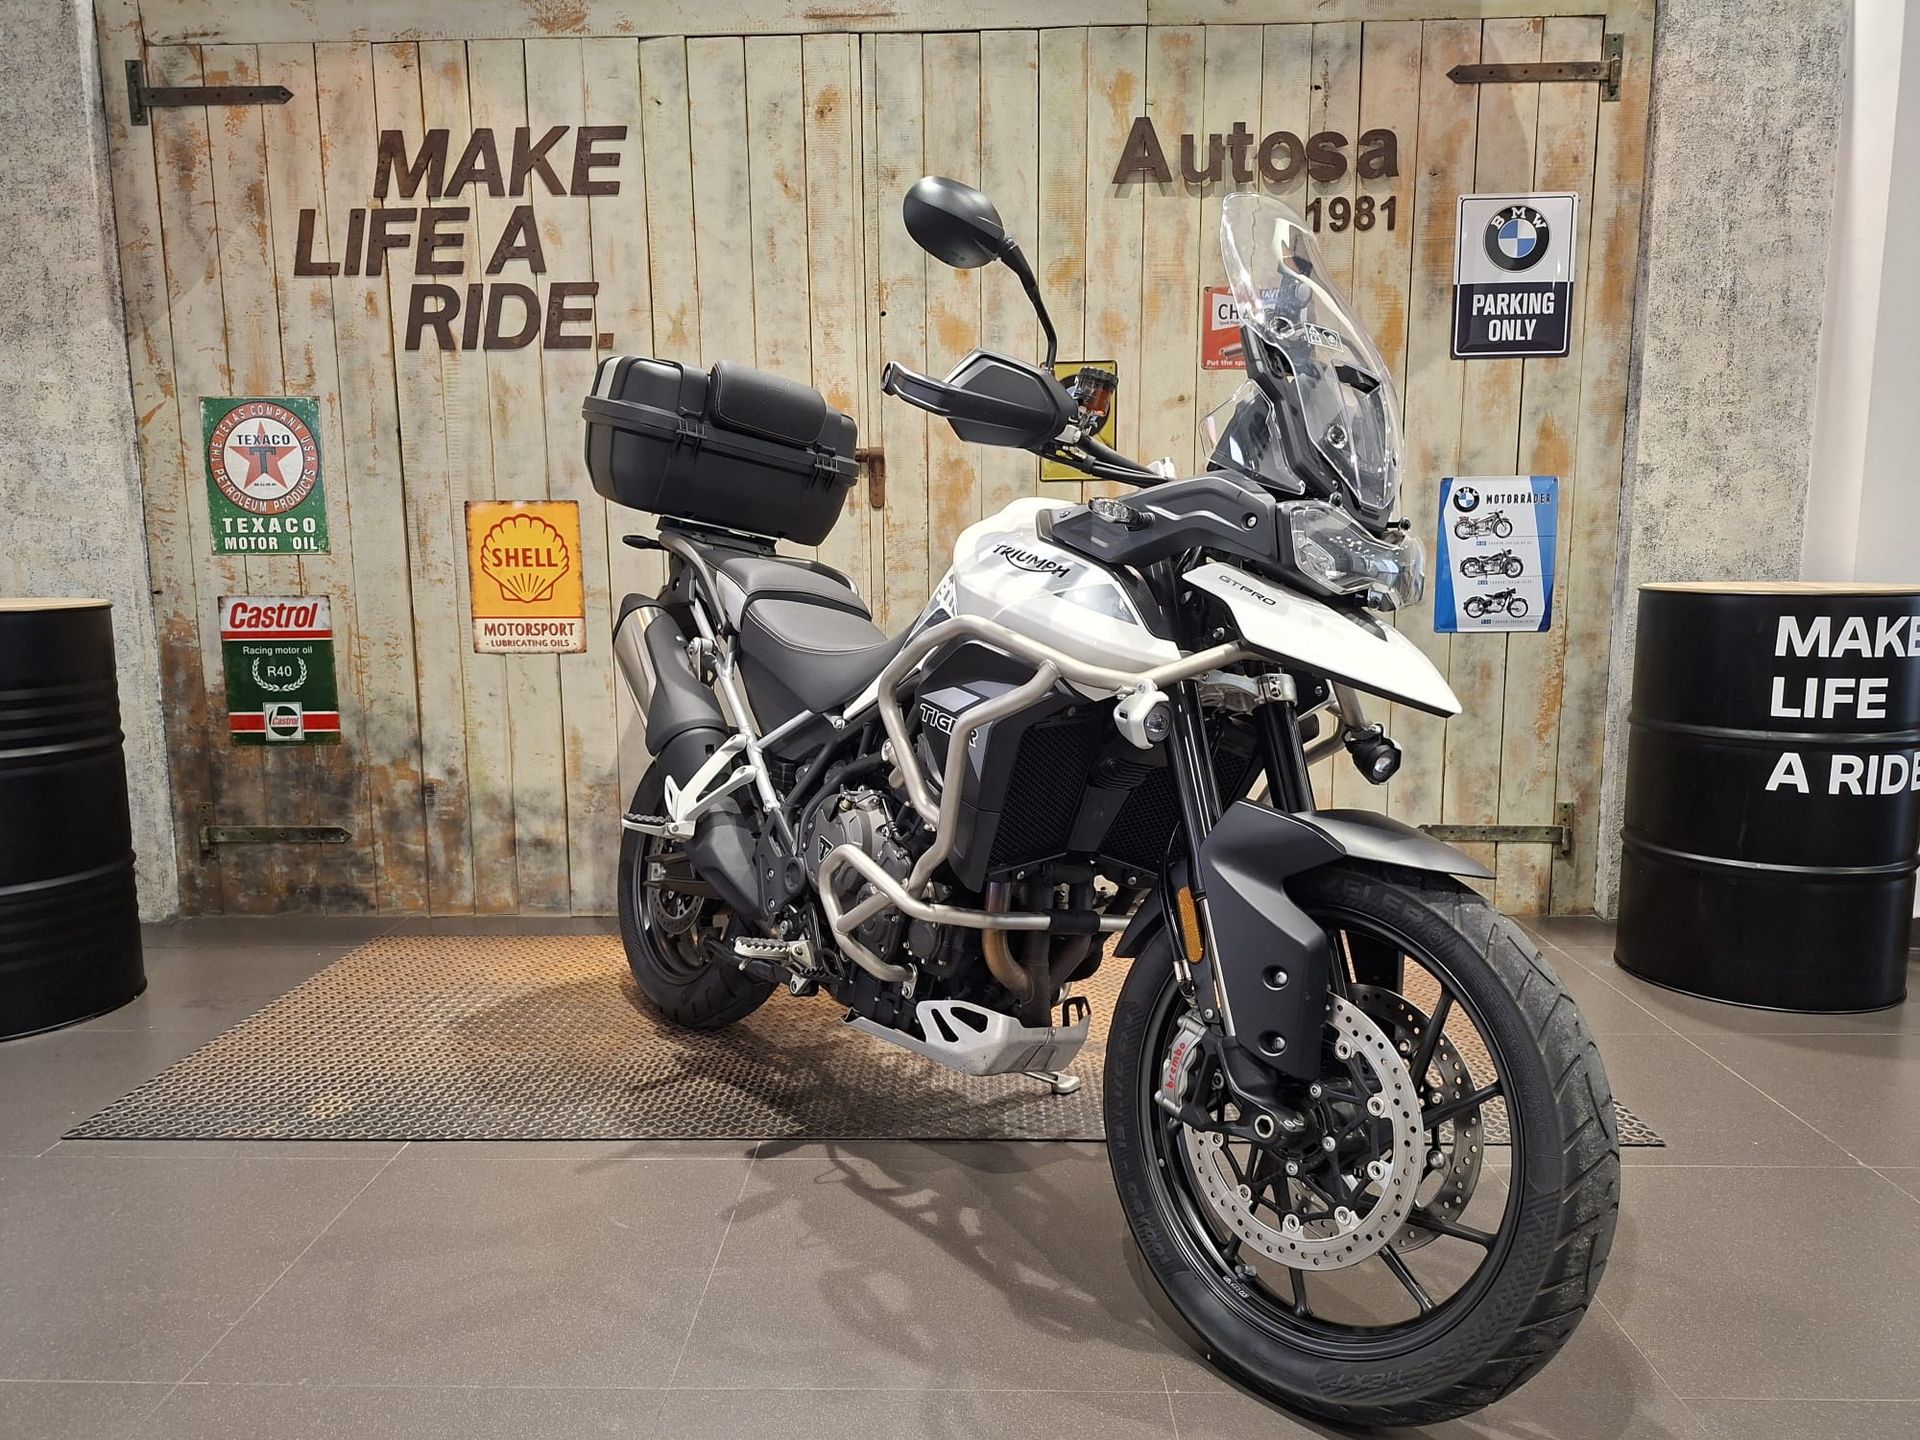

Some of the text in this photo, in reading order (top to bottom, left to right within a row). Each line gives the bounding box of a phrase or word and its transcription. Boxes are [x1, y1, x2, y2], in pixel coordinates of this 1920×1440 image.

[374, 125, 628, 198] MAKE
[1112, 116, 1400, 184] Autosa
[1305, 195, 1397, 233] 1981
[1490, 206, 1547, 230] BMW
[294, 205, 546, 276] LIFE A
[405, 282, 615, 350] RIDE.
[1472, 292, 1555, 316] PARKING
[1488, 318, 1537, 342] ONLY
[216, 408, 246, 438] TEXAS
[250, 405, 303, 432] COMPANY
[211, 441, 223, 463] THE
[236, 434, 291, 445] TEXACO
[214, 468, 316, 512] PETROLEUM PRODUCTS
[222, 517, 316, 533] TEXACO
[224, 536, 318, 550] MOTOR OIL
[492, 547, 558, 568] SHELL
[992, 543, 1071, 579] TRIUMPH
[229, 602, 319, 629] Castrol
[484, 622, 576, 637] MOTORSPORT
[491, 639, 570, 647] LUBRICATING OILS
[242, 646, 273, 656] Racing
[302, 646, 313, 654] oil
[267, 665, 292, 677] R40
[1770, 676, 1889, 719] LIFE
[271, 715, 299, 726] Castrol
[919, 703, 979, 748] TIGR
[1764, 751, 1810, 794] A
[1165, 1042, 1186, 1089] brembo
